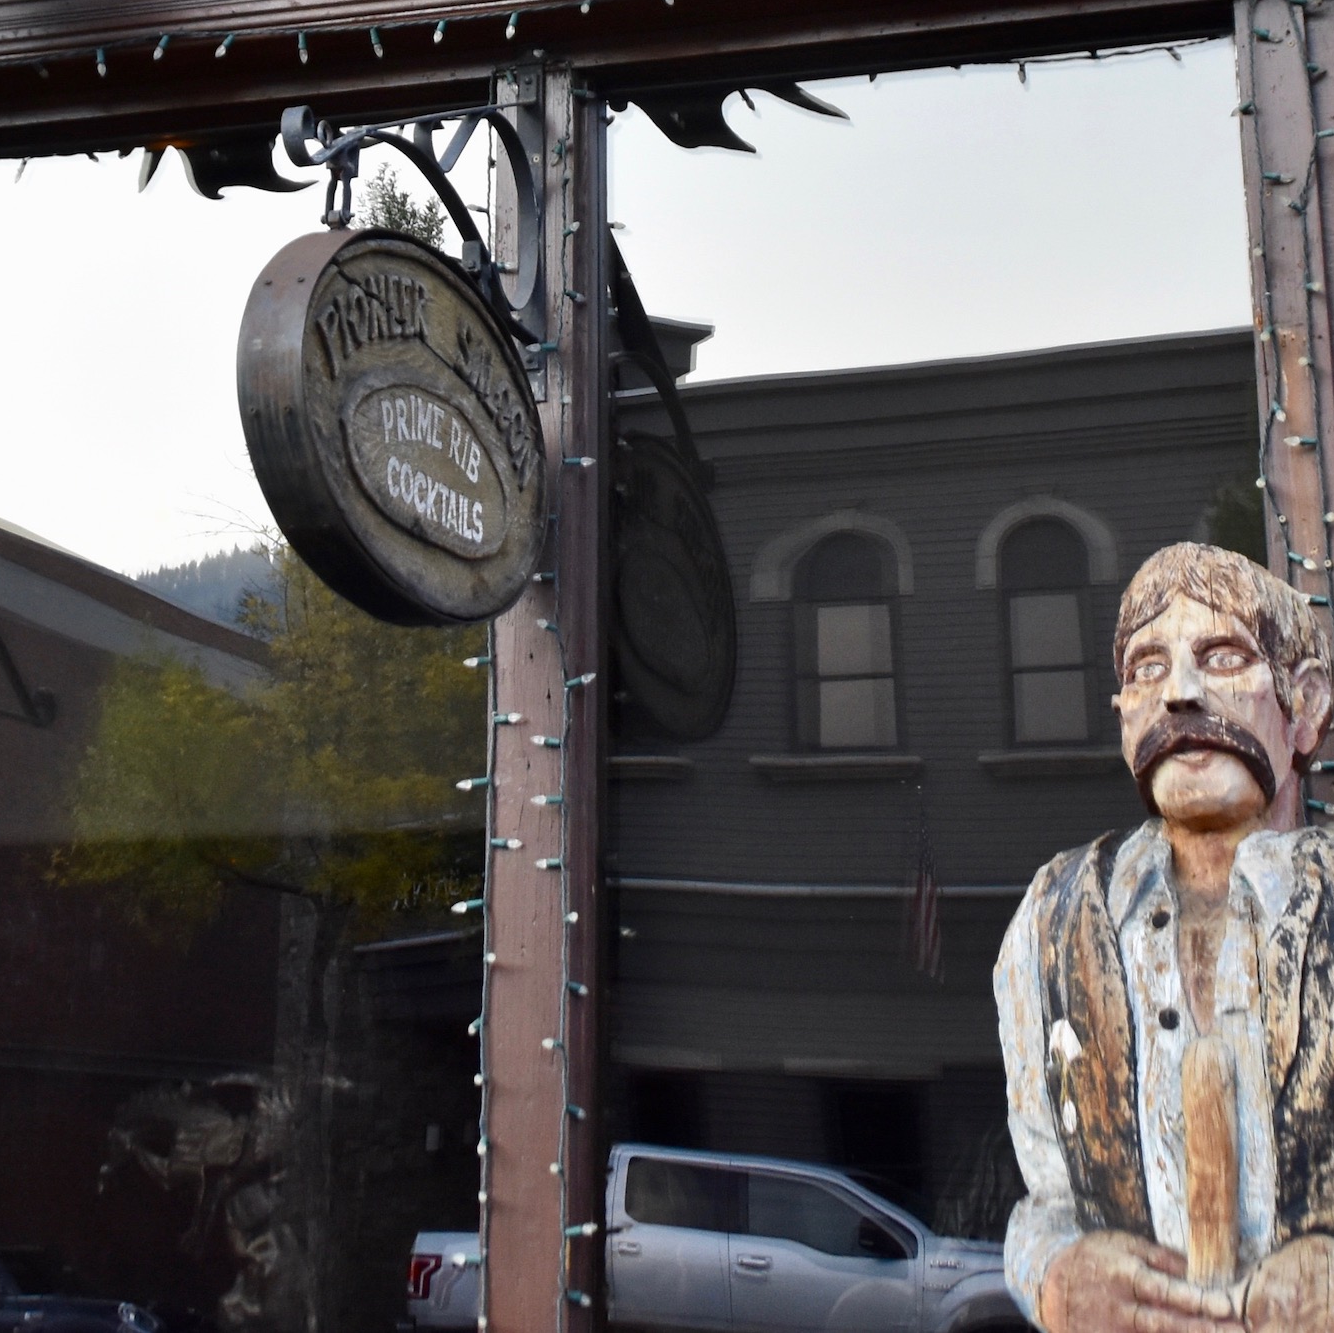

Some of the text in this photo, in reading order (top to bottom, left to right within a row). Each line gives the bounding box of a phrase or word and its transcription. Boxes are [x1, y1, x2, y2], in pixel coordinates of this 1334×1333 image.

[316, 274, 429, 381] PIONEER
[380, 394, 481, 484] PRIME RIB
[386, 455, 484, 544] COCKTAILS
